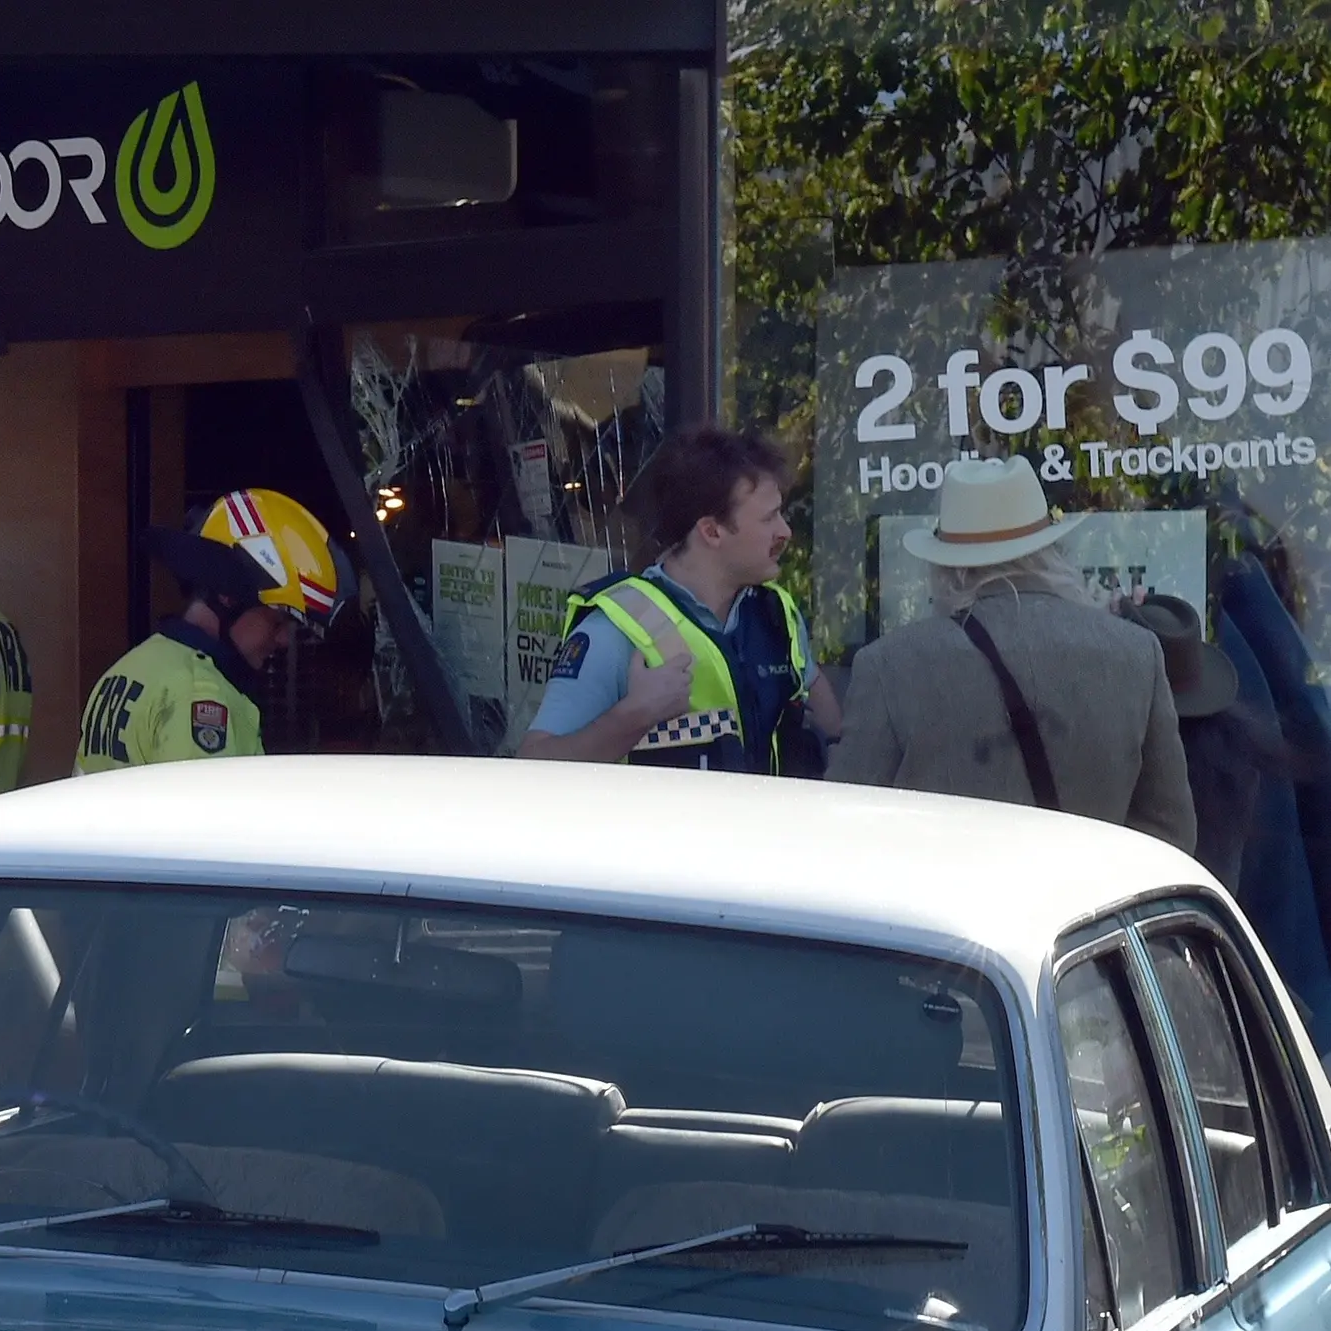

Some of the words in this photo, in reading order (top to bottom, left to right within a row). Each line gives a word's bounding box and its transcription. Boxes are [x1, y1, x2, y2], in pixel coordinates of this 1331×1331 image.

[855, 354, 916, 442] 2
[937, 349, 1089, 437] for
[1112, 328, 1312, 436] $99
[1040, 443, 1073, 482] &
[1080, 431, 1317, 480] Trackpants
[440, 563, 476, 580] ENTRY
[516, 582, 553, 610] PRICE
[517, 634, 545, 654] ON
